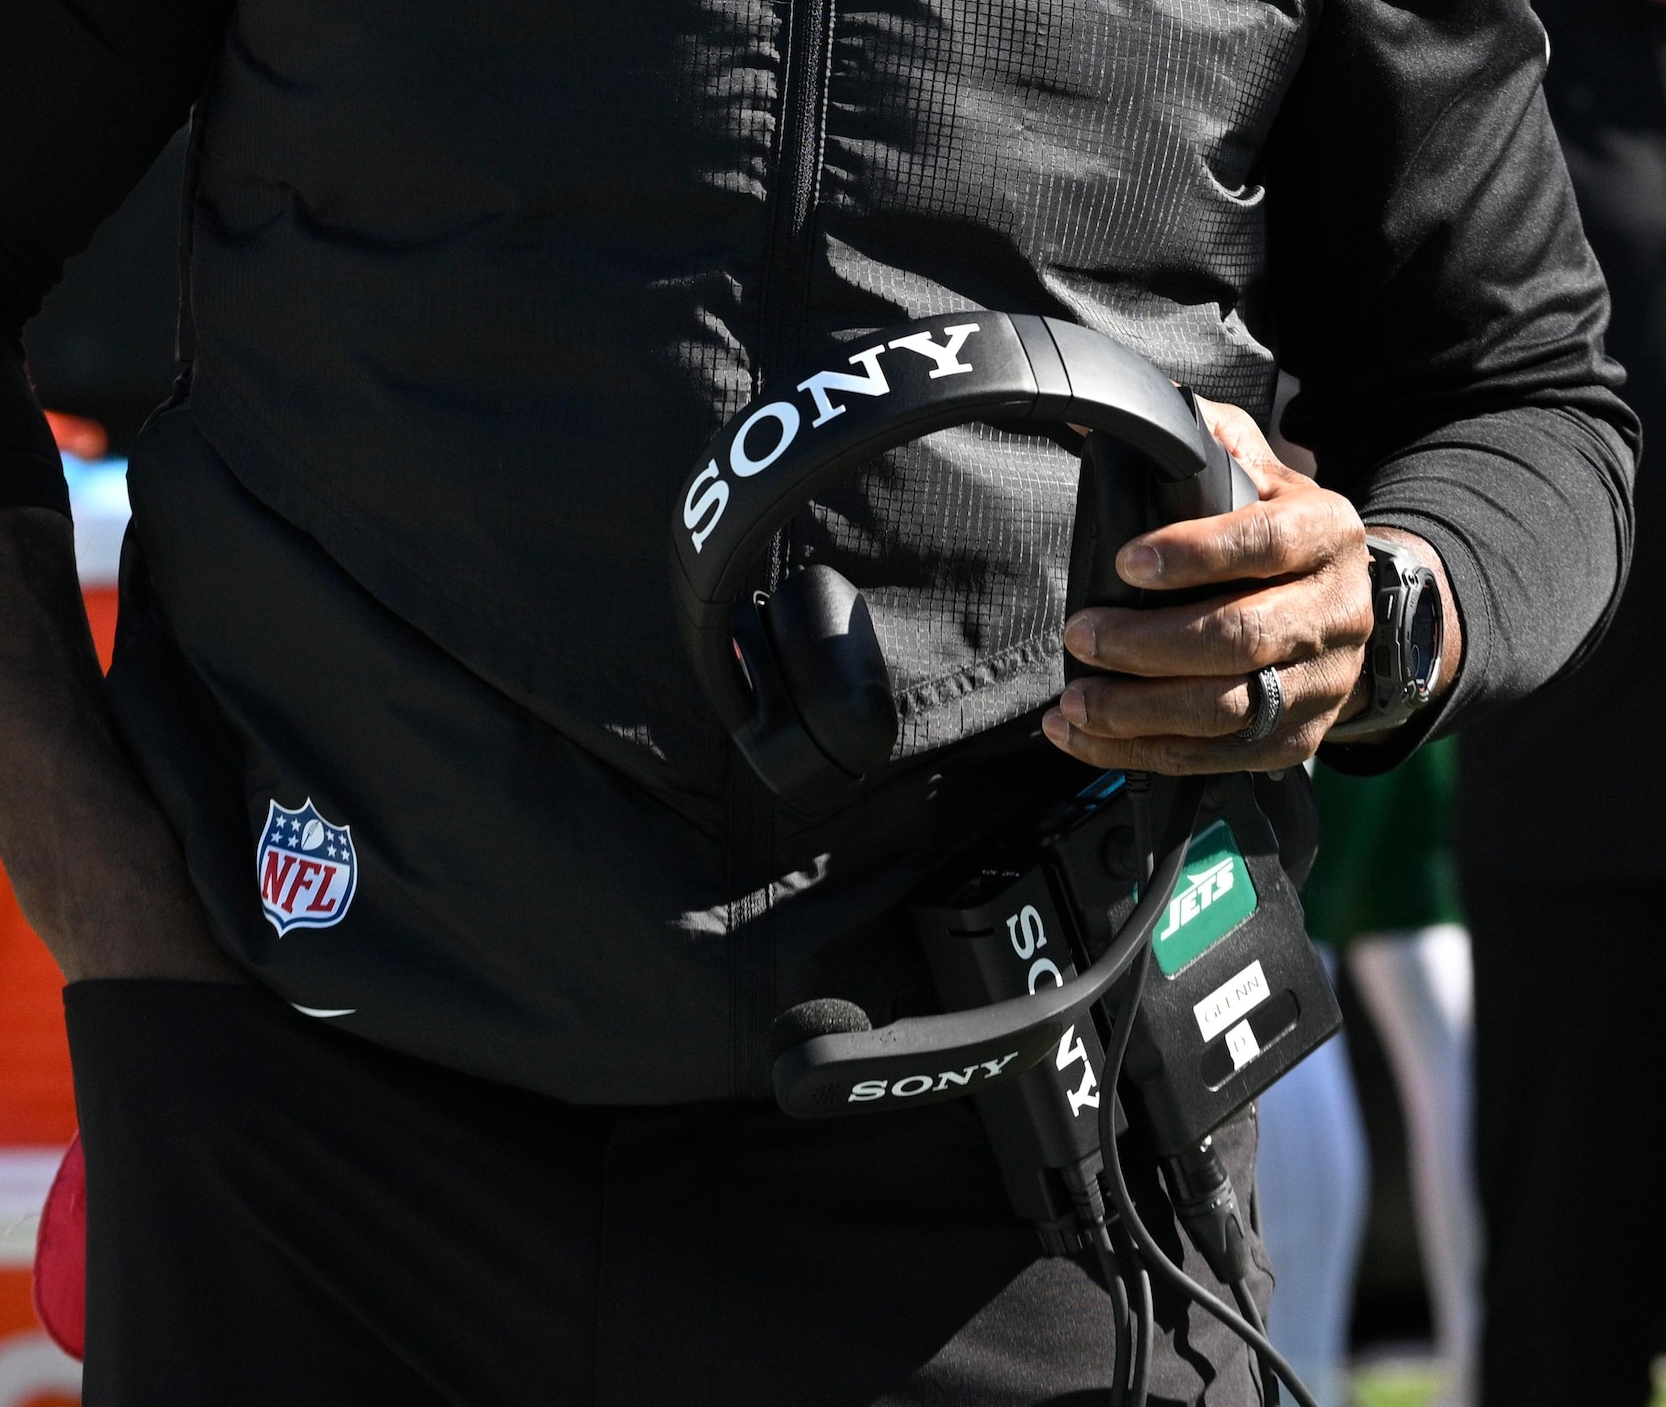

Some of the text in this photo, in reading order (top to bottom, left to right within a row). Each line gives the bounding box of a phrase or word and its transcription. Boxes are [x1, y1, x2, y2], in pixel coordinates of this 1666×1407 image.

[683, 322, 980, 554] SONY
[262, 850, 338, 914] NFL
[1160, 856, 1235, 942] JETS
[847, 1051, 1019, 1103] SONY
